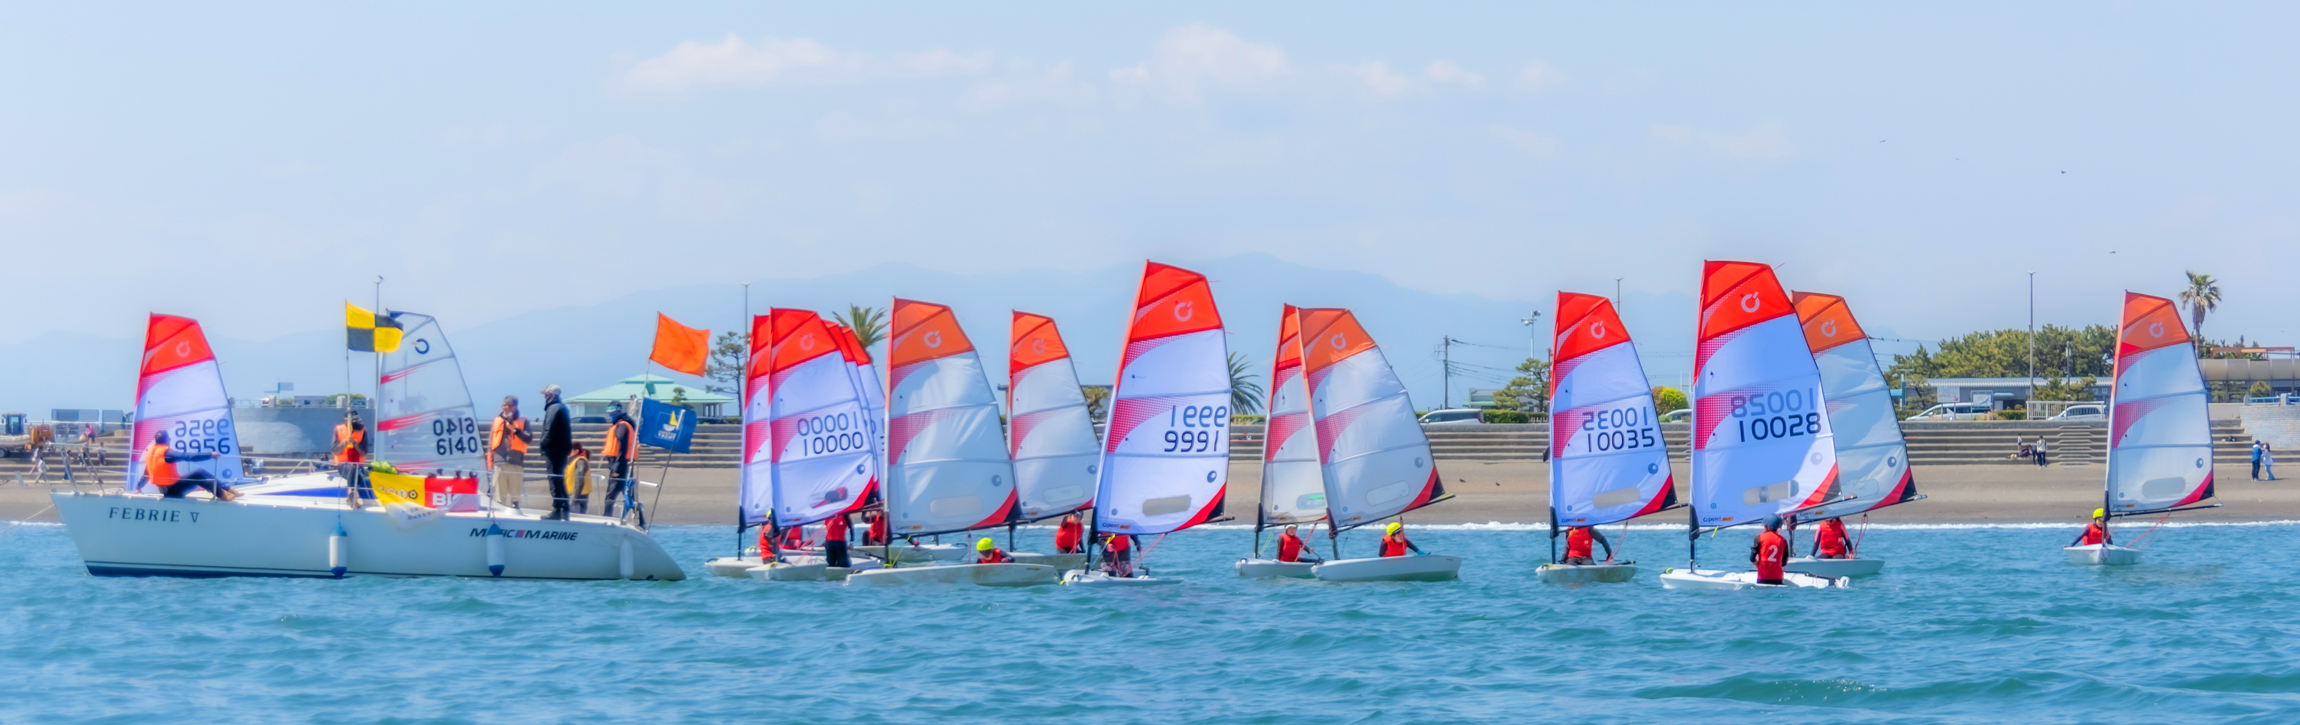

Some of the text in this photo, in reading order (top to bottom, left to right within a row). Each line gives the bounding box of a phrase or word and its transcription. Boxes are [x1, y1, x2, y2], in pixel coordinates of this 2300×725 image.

[1739, 412, 1822, 443] 10028
[436, 436, 478, 455] 6140
[803, 431, 864, 456] 10000
[1164, 430, 1219, 452] 9991
[1588, 427, 1655, 452] 10035
[109, 506, 181, 522] FEBRIE
[470, 528, 579, 541] MIC MARINE
[1767, 544, 1779, 562] 2
